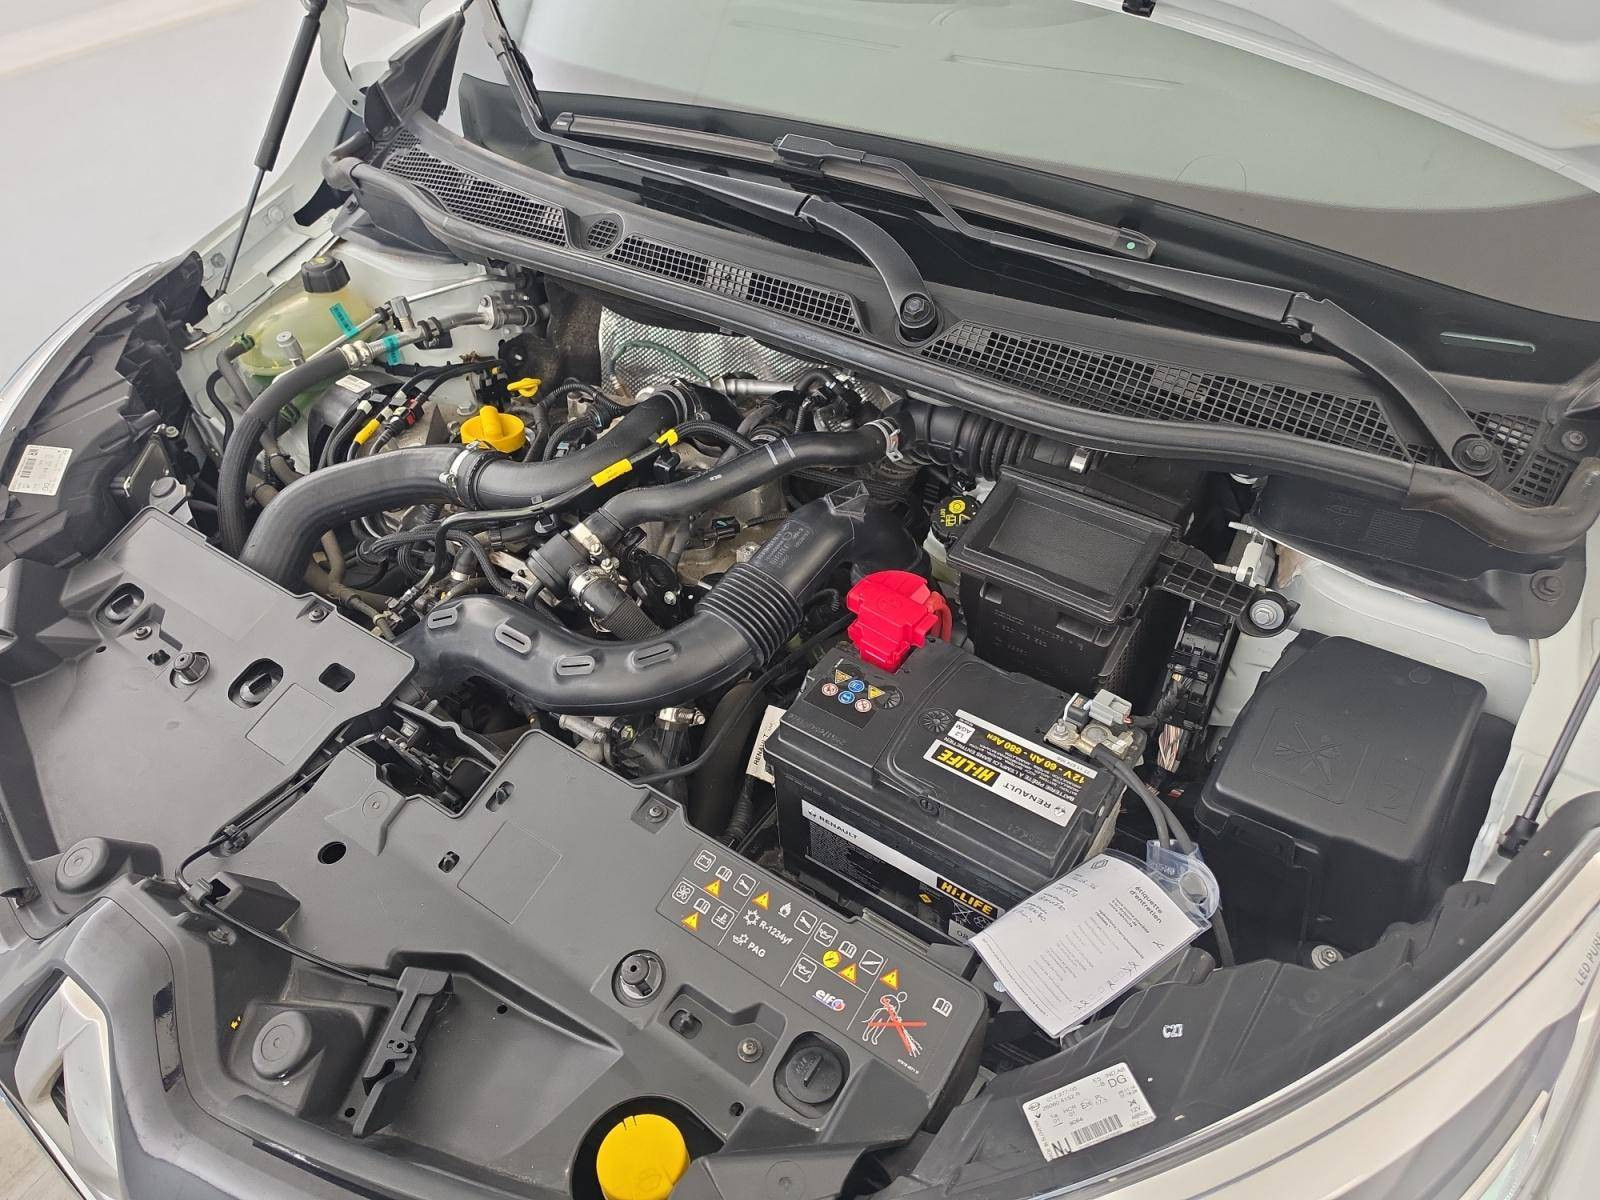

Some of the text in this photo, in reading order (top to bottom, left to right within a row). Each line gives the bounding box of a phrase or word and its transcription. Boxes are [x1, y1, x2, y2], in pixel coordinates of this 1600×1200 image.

[955, 724, 972, 734] AGM
[944, 736, 976, 754] ENTRETIEN
[1004, 742, 1022, 754] 680
[976, 752, 992, 762] SANS
[1030, 753, 1044, 764] Ah
[1044, 760, 1057, 770] 60
[1003, 782, 1051, 808] RENAULT
[1044, 785, 1074, 801] BATTERIE
[819, 816, 858, 840] RENAULT
[1130, 890, 1162, 923] d'entretien
[1135, 886, 1162, 914] étiquette
[759, 920, 793, 944] R-1234yf
[748, 942, 766, 957] PAG
[1576, 962, 1590, 986] LED
[1107, 1073, 1127, 1088] DG
[1050, 1136, 1072, 1157] NJ
